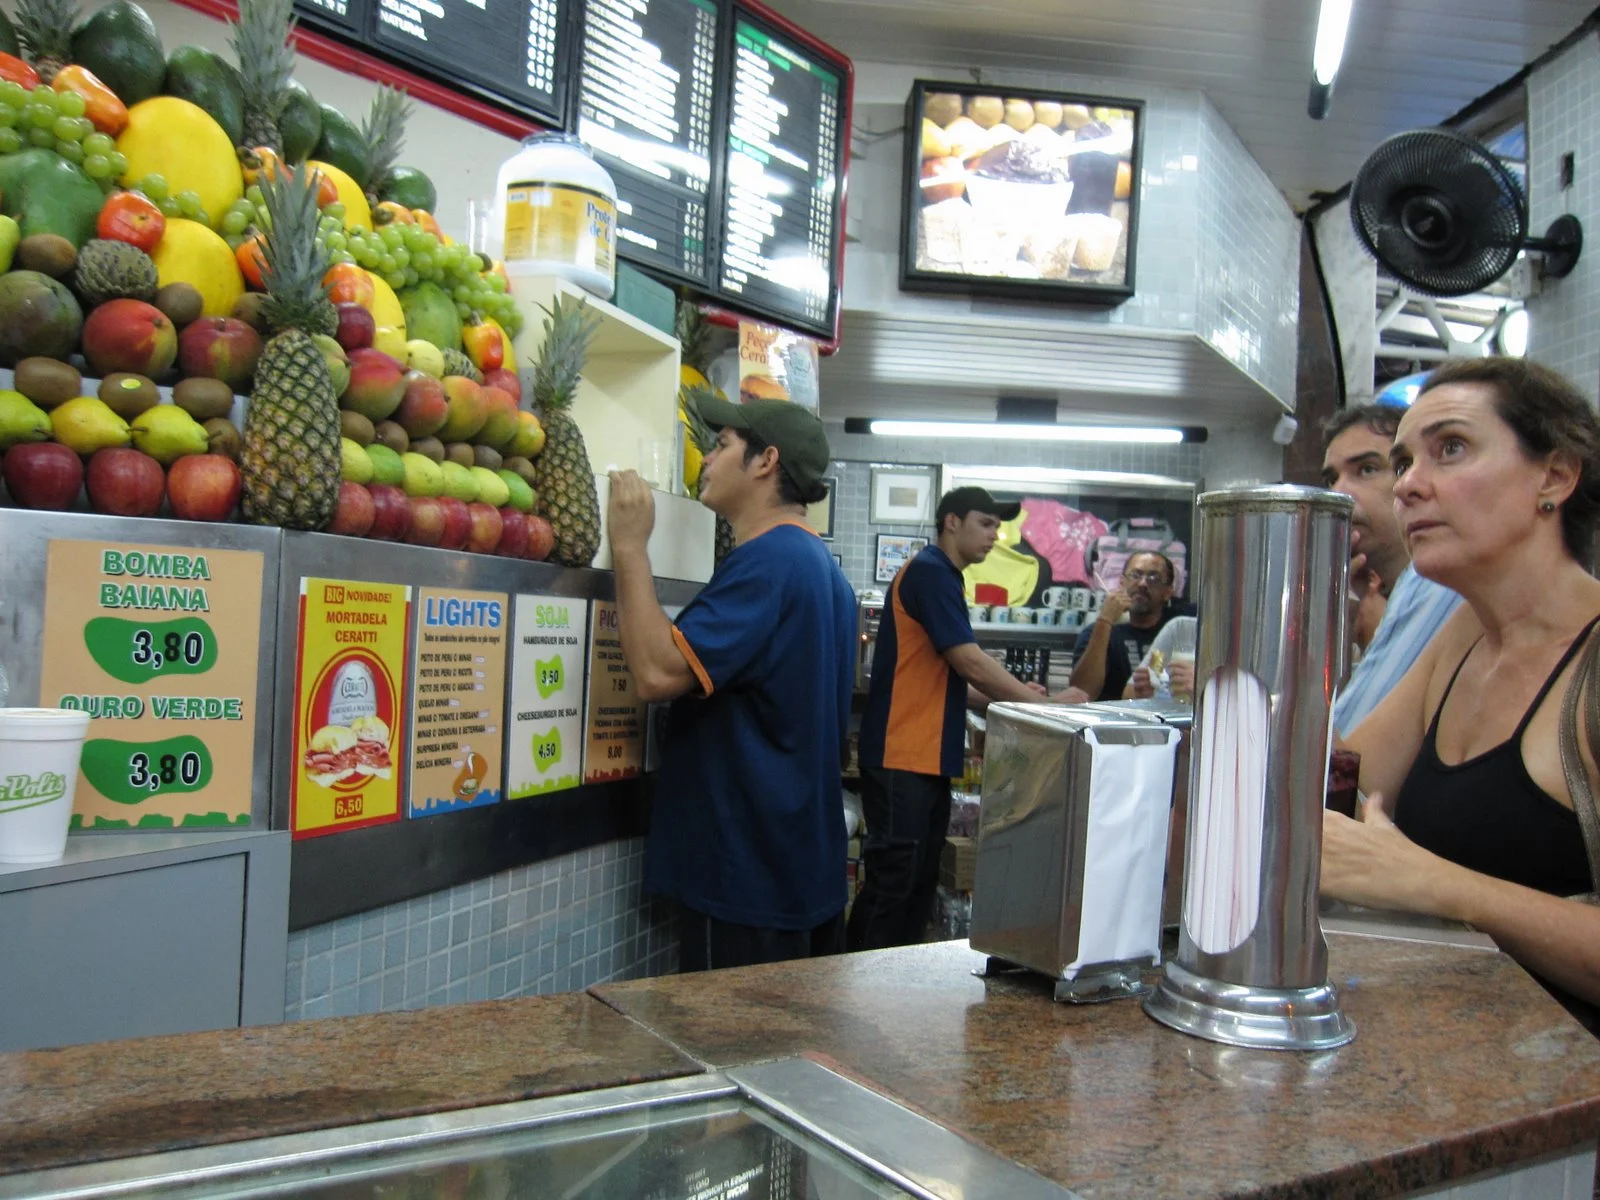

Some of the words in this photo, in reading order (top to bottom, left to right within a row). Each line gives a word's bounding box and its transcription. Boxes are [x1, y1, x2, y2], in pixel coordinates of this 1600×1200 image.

[102, 550, 211, 580] BOMBA
[99, 583, 210, 612] BAIANA
[326, 586, 344, 603] BIG
[347, 590, 392, 604] NOVIDADE!
[326, 611, 388, 625] MORTADELA
[426, 596, 502, 629] LIGHTS
[536, 604, 570, 629] SOJA
[335, 630, 378, 643] CERATTI
[523, 636, 558, 646] HAMBURGUER
[558, 636, 566, 645] DE
[566, 636, 578, 646] SOJA
[133, 629, 205, 670] 3,80
[60, 694, 144, 719] OURO
[152, 696, 243, 720] VERDE
[418, 699, 434, 710] QUEIJO
[517, 710, 557, 722] CHEESEBURGER
[558, 708, 564, 718] DE
[566, 708, 578, 718] SOJA
[538, 742, 556, 758] 4,50
[129, 751, 201, 791] 3,80
[6, 771, 67, 799] Polis
[336, 798, 362, 815] 6,50
